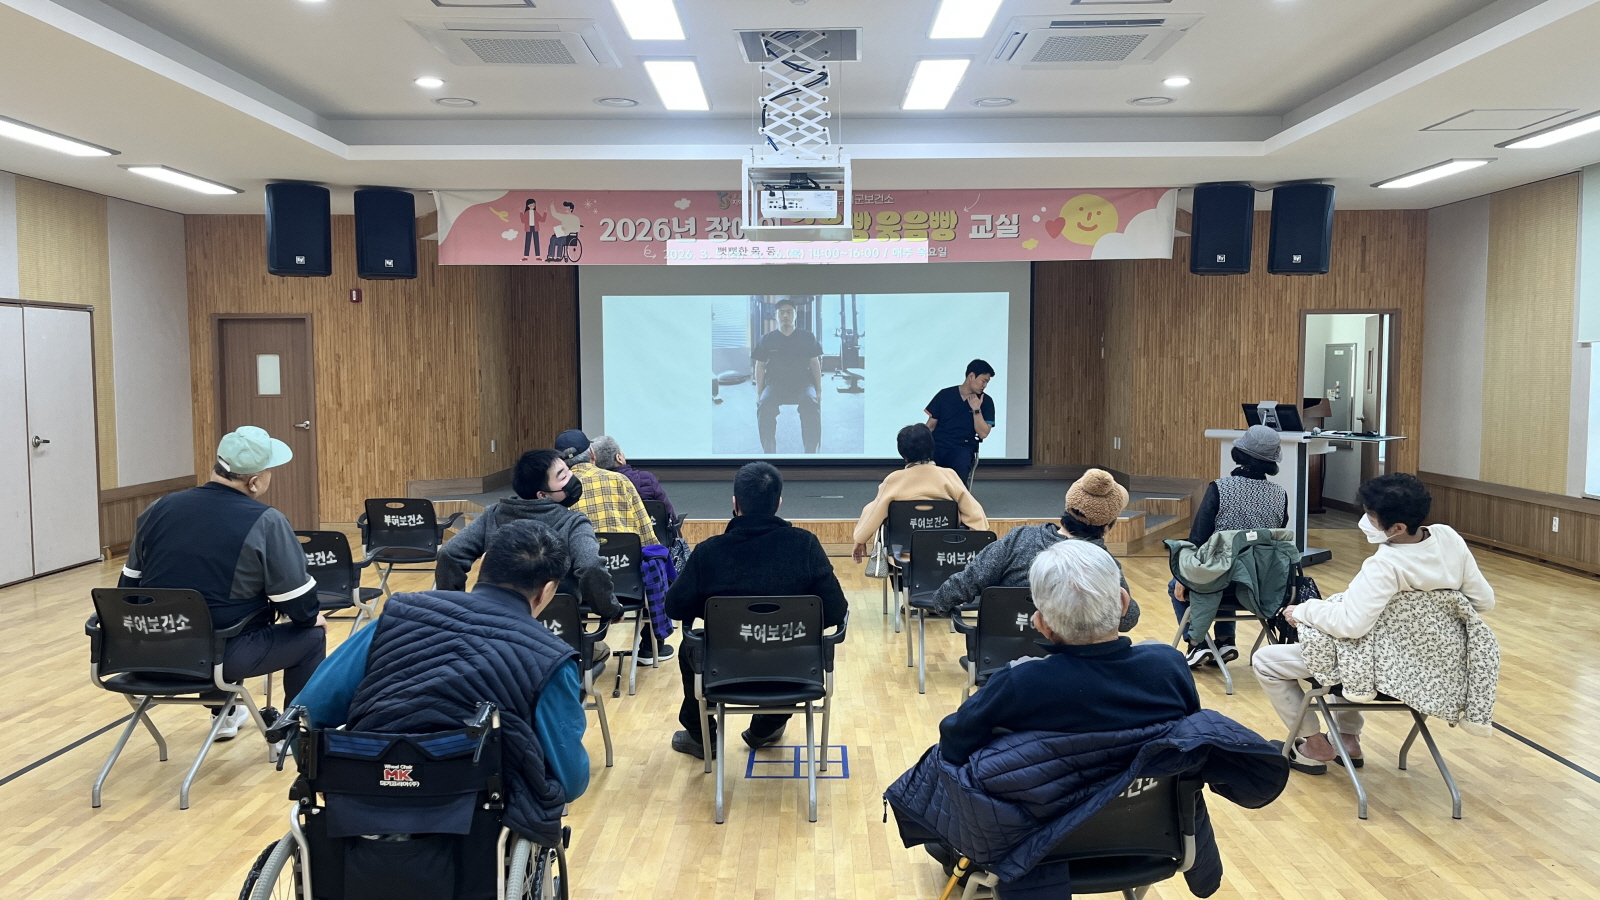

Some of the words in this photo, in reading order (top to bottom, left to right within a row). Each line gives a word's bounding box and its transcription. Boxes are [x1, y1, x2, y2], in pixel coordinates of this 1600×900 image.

[837, 193, 894, 205] 부군보건소
[600, 217, 697, 242] 2026년
[875, 210, 959, 242] 웃음빵
[968, 213, 1021, 239] 교실
[663, 249, 697, 260] 2026.
[892, 247, 913, 258] 매주
[917, 246, 948, 258] 목요일
[384, 514, 425, 527] 부여보건소
[909, 516, 949, 529] 부여보건소
[122, 613, 193, 635] 부여보건소
[739, 621, 807, 643] 부여보건소
[384, 769, 413, 781] MK
